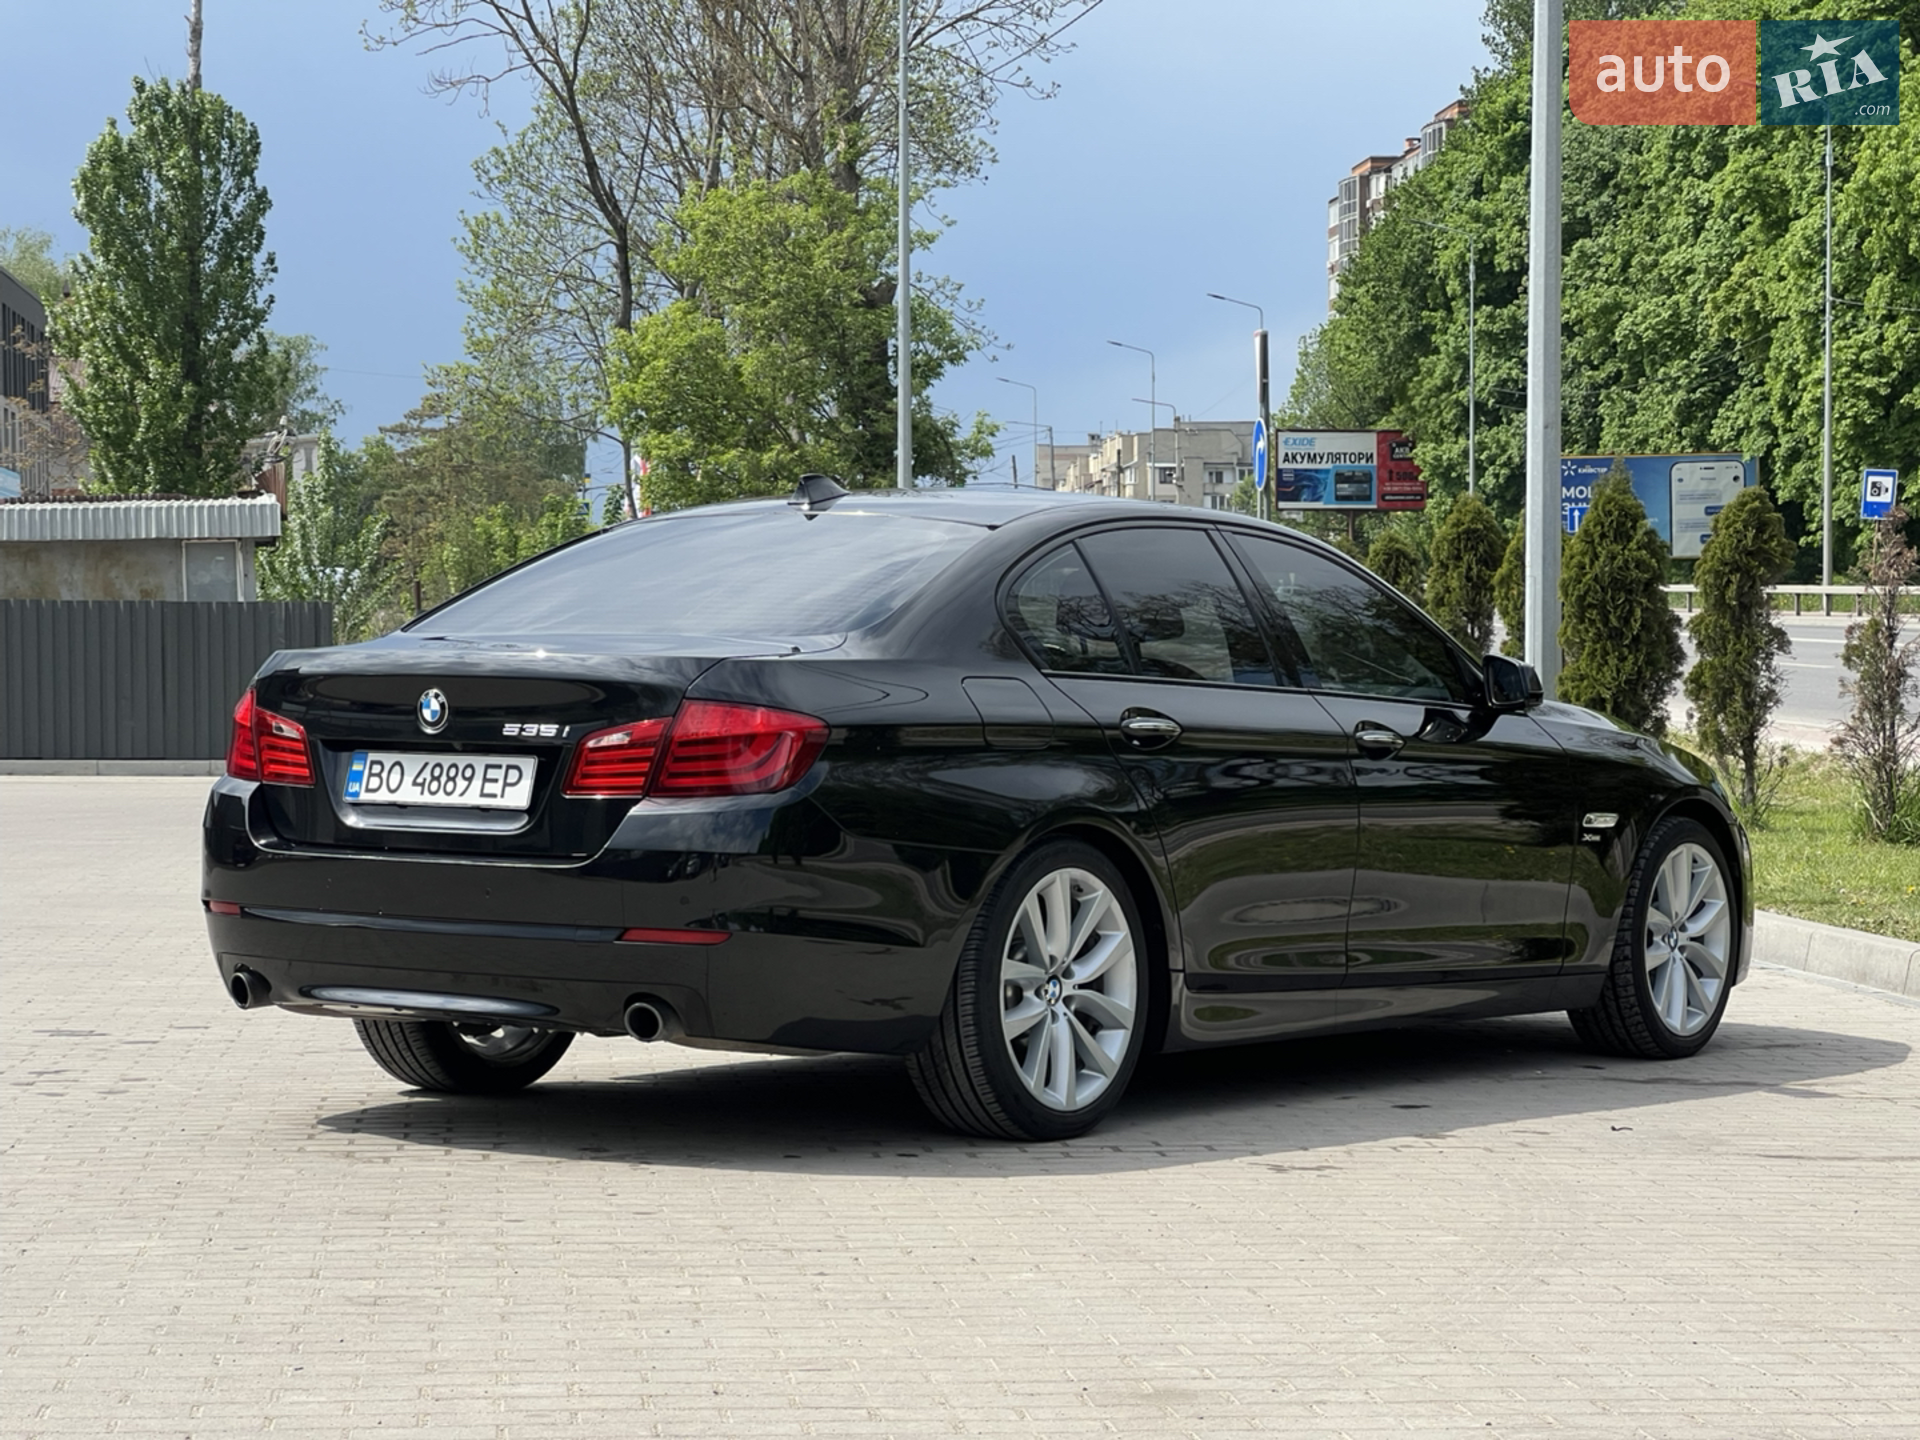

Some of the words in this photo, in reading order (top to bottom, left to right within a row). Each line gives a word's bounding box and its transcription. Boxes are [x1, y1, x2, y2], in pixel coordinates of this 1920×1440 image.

[1282, 437, 1317, 447] EXIDE
[1282, 451, 1374, 465] АКУМУЛЯТОРИ
[364, 759, 405, 795] BO
[411, 761, 476, 798] 4889
[479, 763, 523, 799] EP
[348, 781, 360, 793] UA
